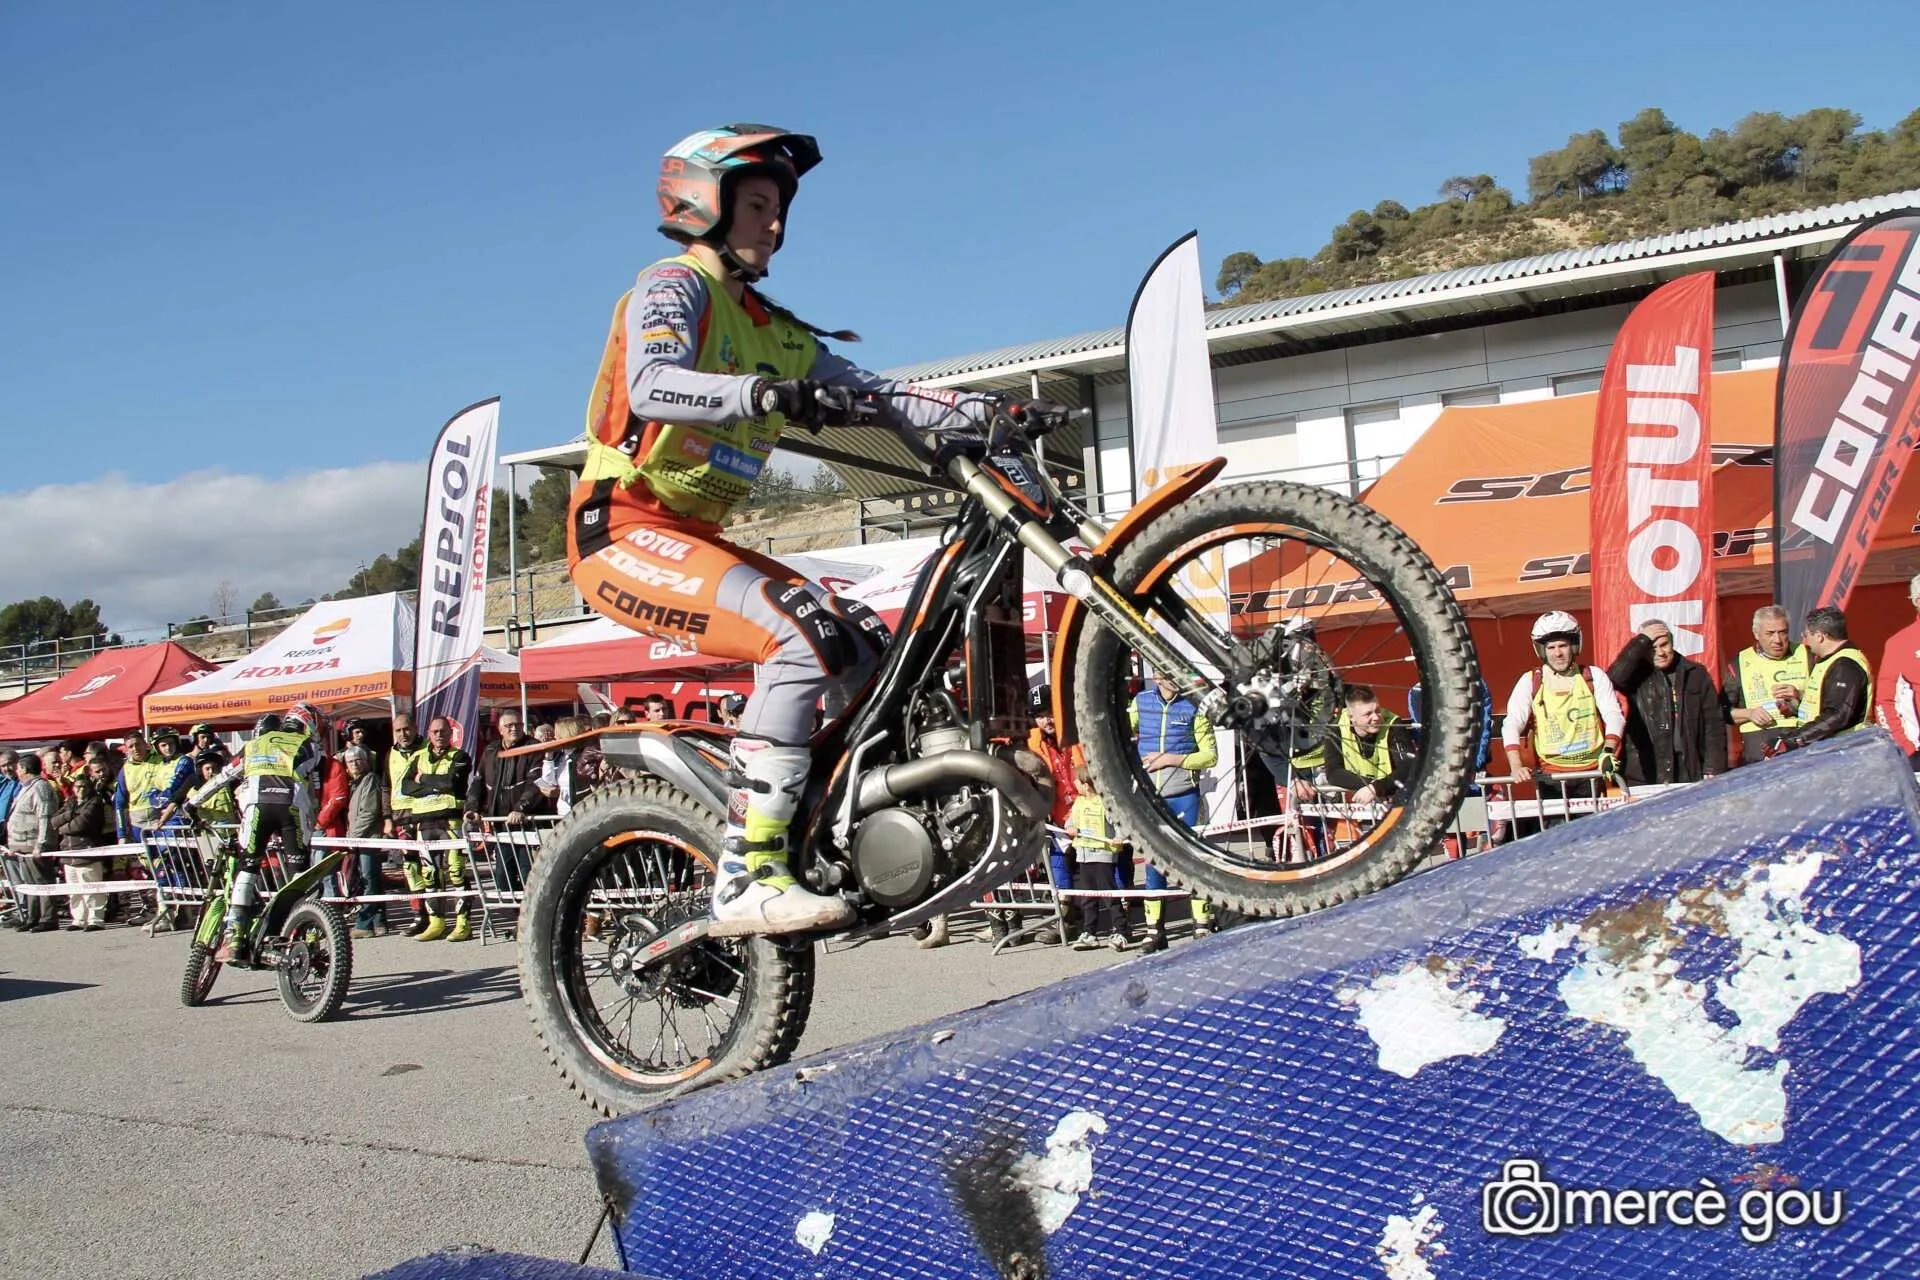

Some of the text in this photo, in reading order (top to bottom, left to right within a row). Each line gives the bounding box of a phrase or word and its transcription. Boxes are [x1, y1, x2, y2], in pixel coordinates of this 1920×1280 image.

[645, 342, 679, 354] iati
[649, 389, 723, 408] COMAS
[432, 434, 471, 638] REPSOL
[472, 482, 489, 592] HONDA
[597, 580, 710, 635] COMAS
[232, 657, 341, 680] HONDA
[268, 681, 388, 704] Repsol Honda Team
